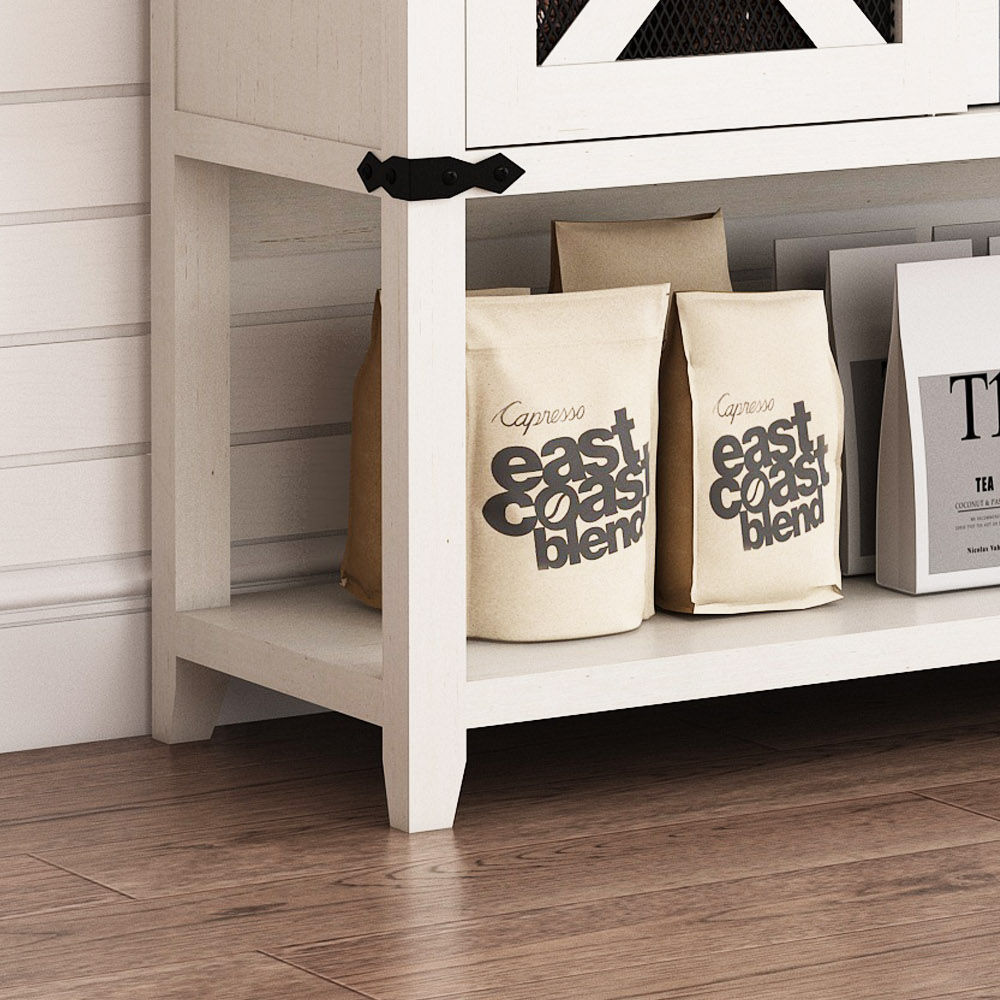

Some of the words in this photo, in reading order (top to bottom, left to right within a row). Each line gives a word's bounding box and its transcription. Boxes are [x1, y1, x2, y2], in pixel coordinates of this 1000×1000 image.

[491, 401, 585, 436] Capresso
[713, 393, 775, 424] Capresso
[491, 407, 640, 492] east
[712, 400, 814, 479] east
[709, 434, 830, 520] coast
[975, 476, 994, 492] TEA
[739, 485, 825, 551] blend
[955, 499, 984, 510] COCONUT
[534, 497, 647, 571] blend
[967, 546, 988, 554] Nicolas
